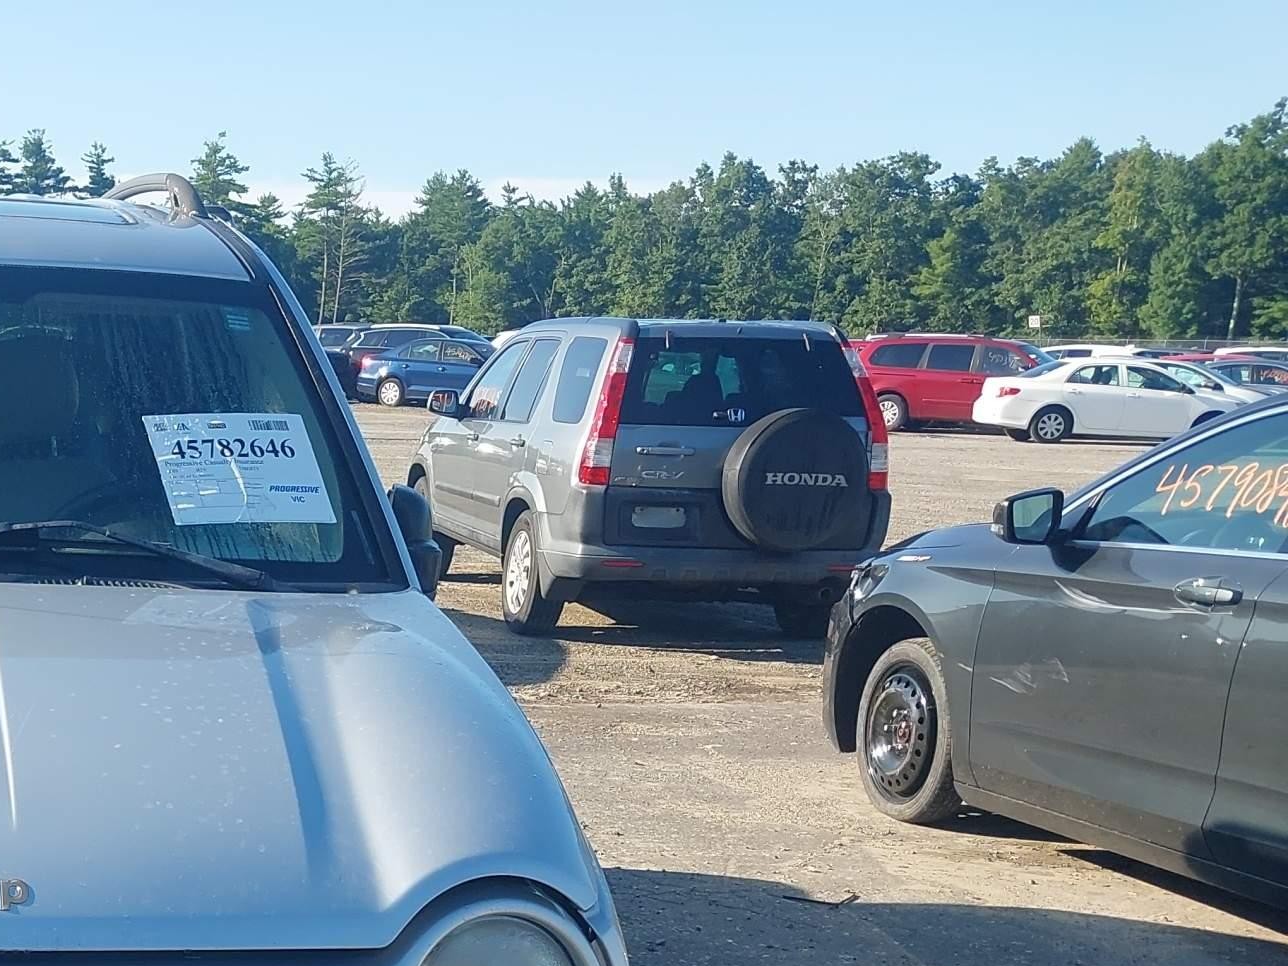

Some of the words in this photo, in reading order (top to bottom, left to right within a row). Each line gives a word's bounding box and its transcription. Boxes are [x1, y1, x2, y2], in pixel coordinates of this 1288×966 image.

[171, 437, 296, 460] 45782646
[764, 471, 849, 488] HONDA
[269, 485, 320, 493] PROGRESSIVE
